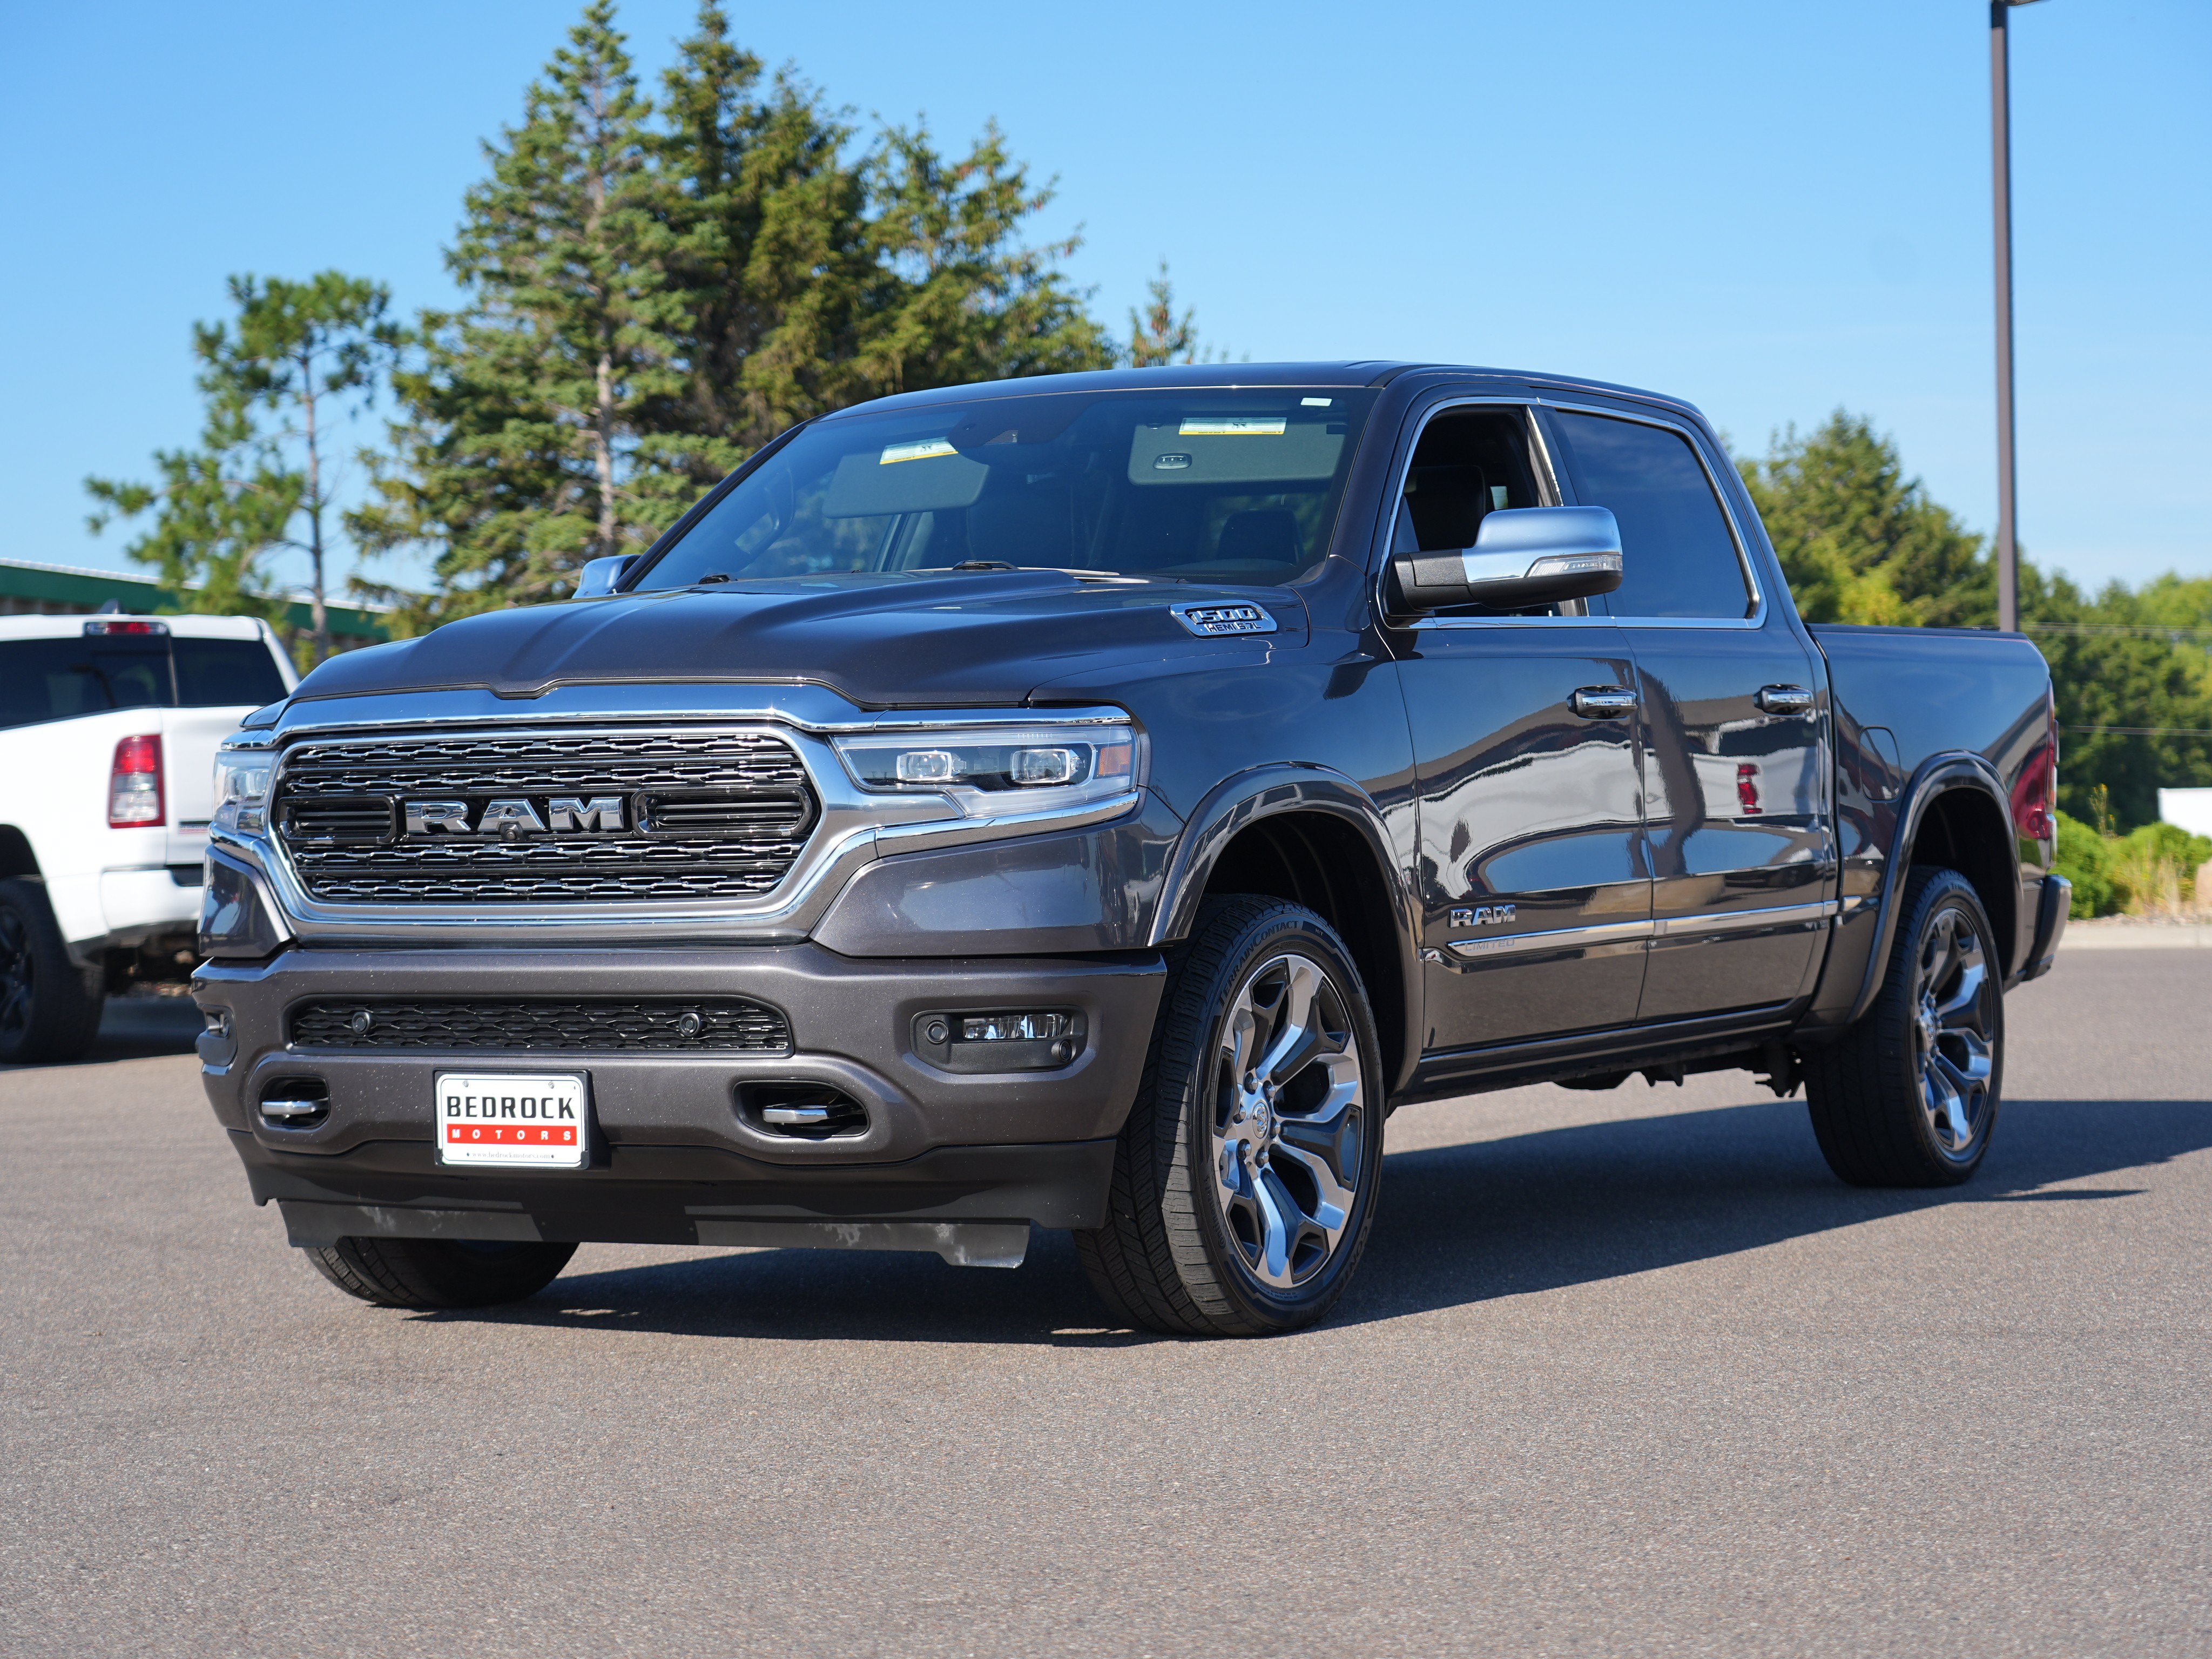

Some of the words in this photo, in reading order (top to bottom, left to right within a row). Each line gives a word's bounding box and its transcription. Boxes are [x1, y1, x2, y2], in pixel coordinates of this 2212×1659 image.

[1188, 608, 1257, 624] 1500
[1207, 623, 1237, 632] HEMI
[405, 797, 624, 833] RAM
[1450, 904, 1516, 928] RAM
[1315, 928, 1324, 936] H/T
[1465, 939, 1515, 952] LIMITED
[447, 1096, 576, 1119] BEDROCK
[452, 1129, 571, 1141] MOTORS
[472, 1151, 550, 1159] www.bedrockmotors.com
